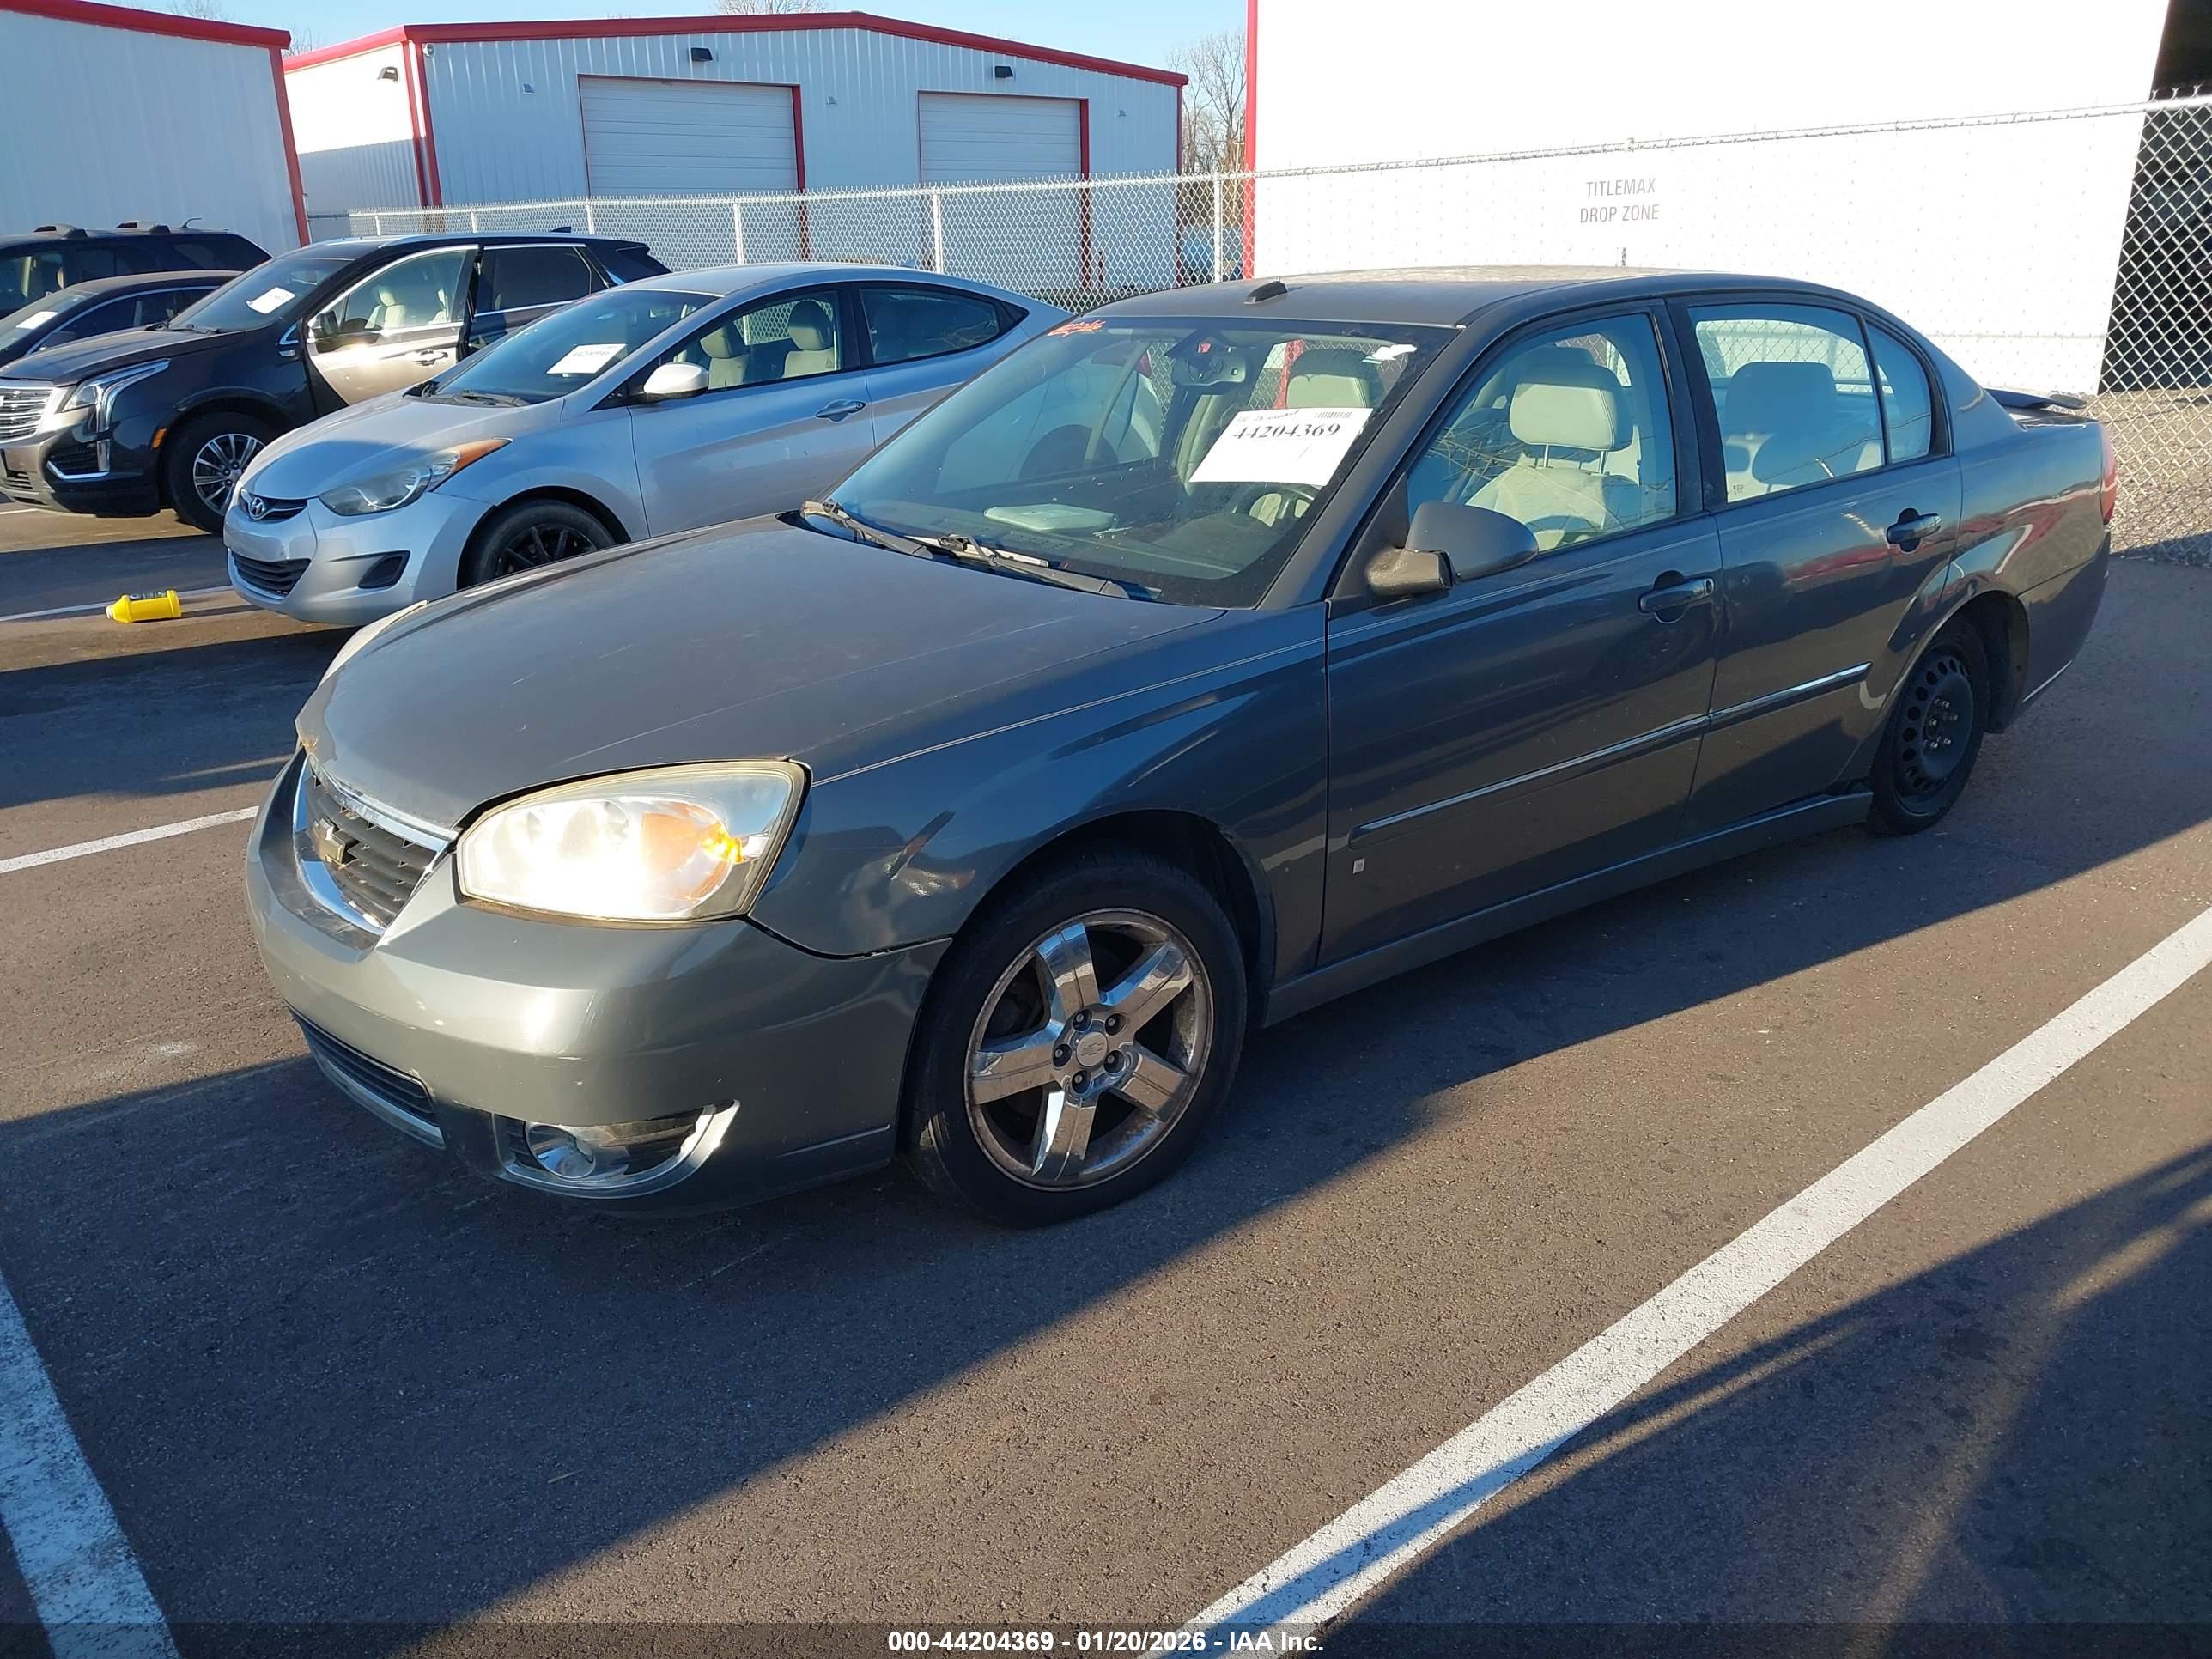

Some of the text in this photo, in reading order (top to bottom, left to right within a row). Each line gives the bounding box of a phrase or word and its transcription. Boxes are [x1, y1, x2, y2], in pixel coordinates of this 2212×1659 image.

[1586, 178, 1656, 197] TITLEMAX
[1580, 204, 1660, 223] DROP ZONE
[1233, 423, 1340, 439] 44204369
